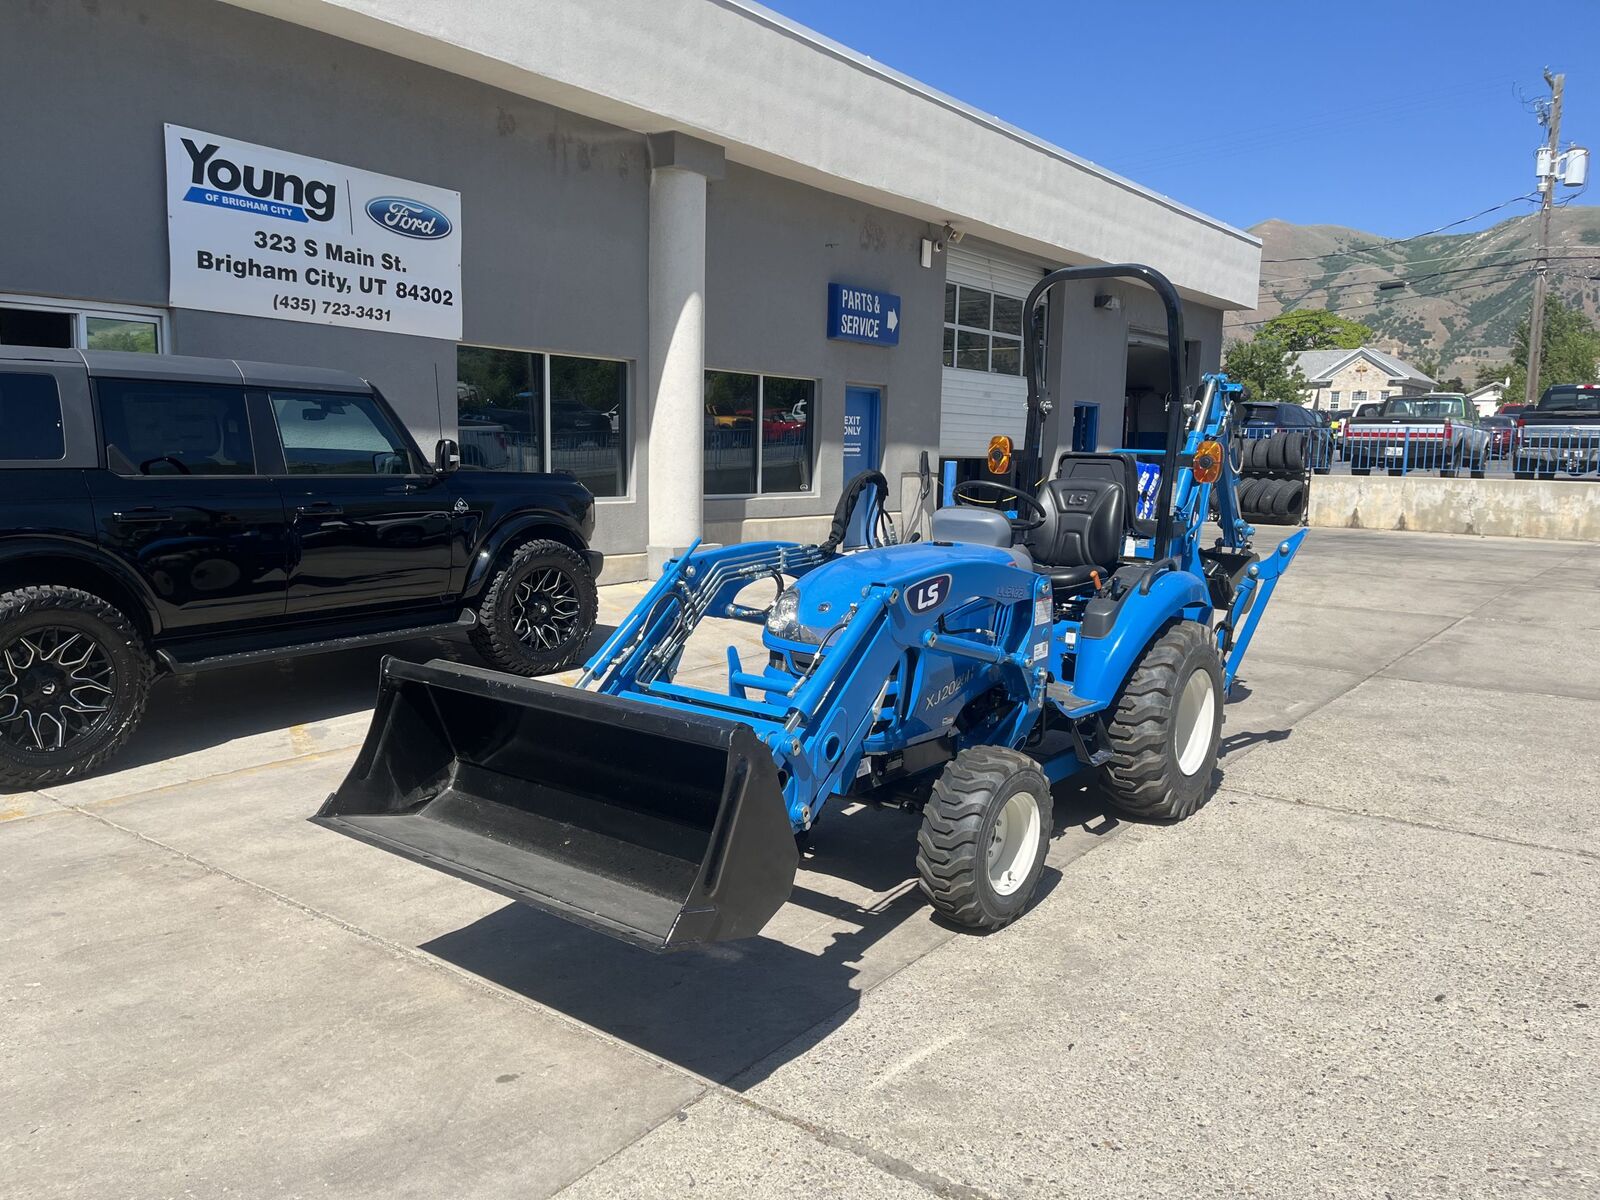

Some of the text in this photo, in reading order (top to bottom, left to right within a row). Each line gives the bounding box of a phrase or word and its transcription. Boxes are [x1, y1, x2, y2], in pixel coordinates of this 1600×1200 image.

[180, 137, 336, 222] Young
[205, 192, 293, 217] OF BRIGHAM CITY
[384, 201, 436, 235] Ford
[254, 230, 407, 273] 323 S Main St.
[197, 250, 453, 306] Brigham City, UT 84302
[272, 293, 392, 322] (435) 723-3431
[842, 289, 881, 314] PARTS &
[841, 314, 880, 338] SERVICE
[844, 415, 861, 425] EXIT
[1068, 494, 1088, 506] LS
[917, 583, 939, 610] LS
